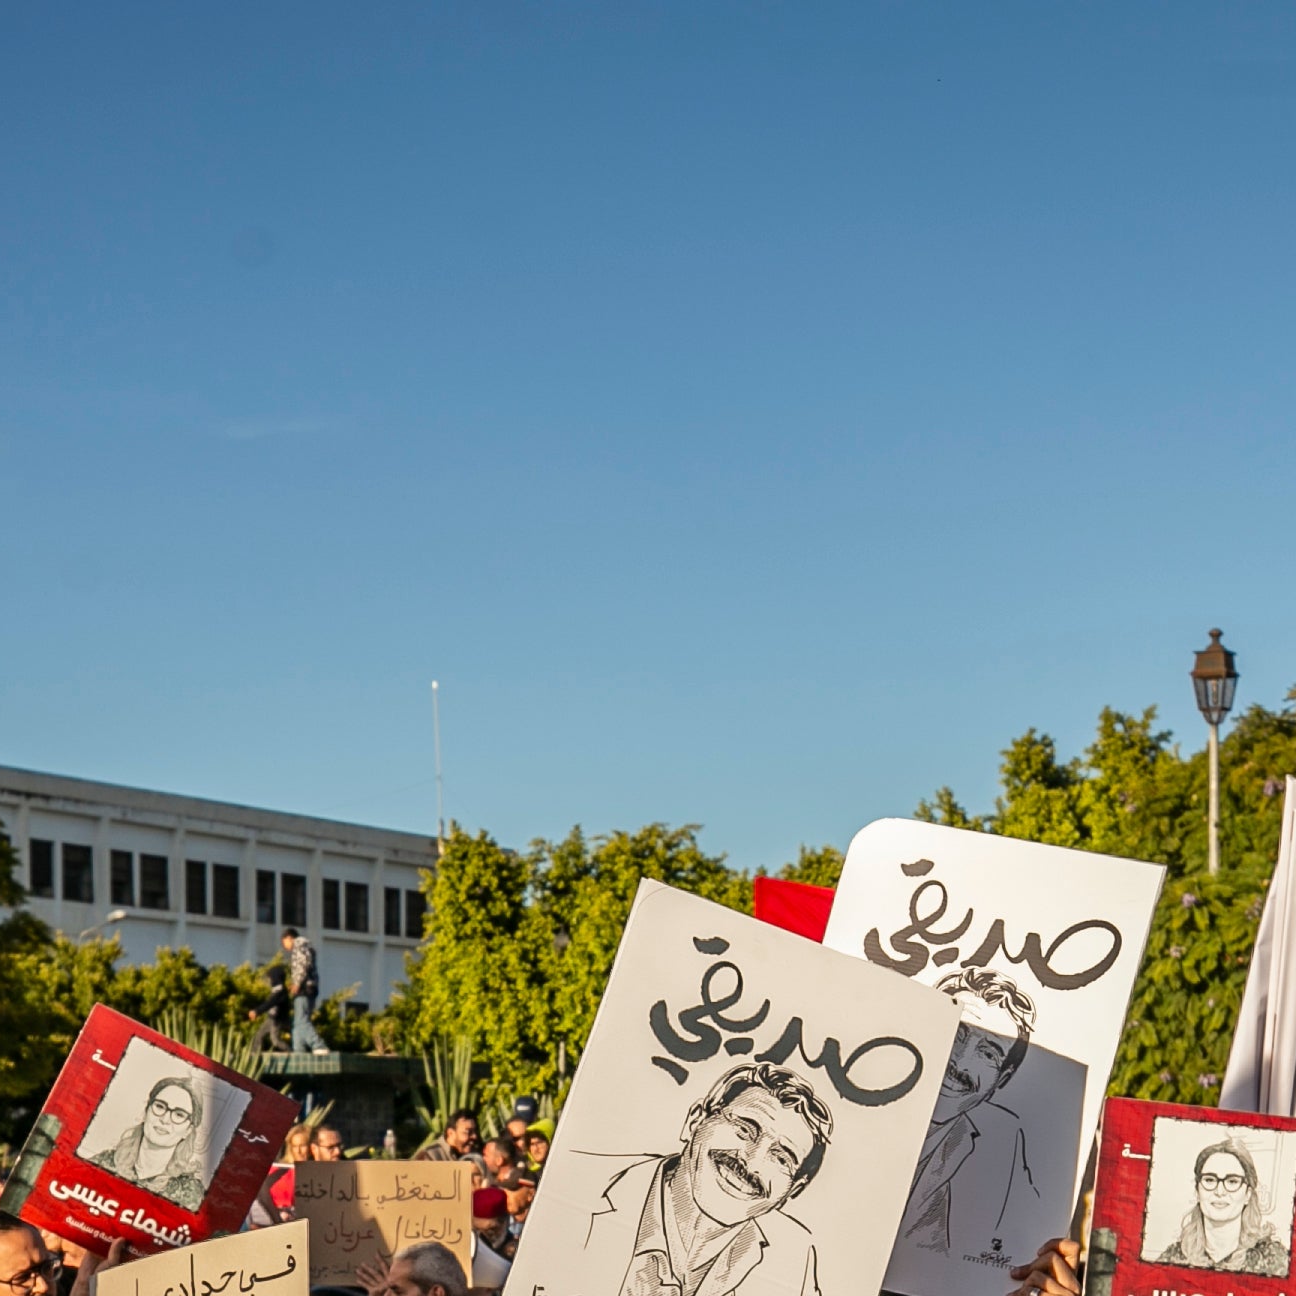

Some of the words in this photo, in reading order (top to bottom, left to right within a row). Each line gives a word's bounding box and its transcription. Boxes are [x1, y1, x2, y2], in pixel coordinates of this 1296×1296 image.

[649, 936, 924, 1107] صديقي
[48, 1180, 119, 1217] عيسى
[120, 1206, 193, 1248] شيماء
